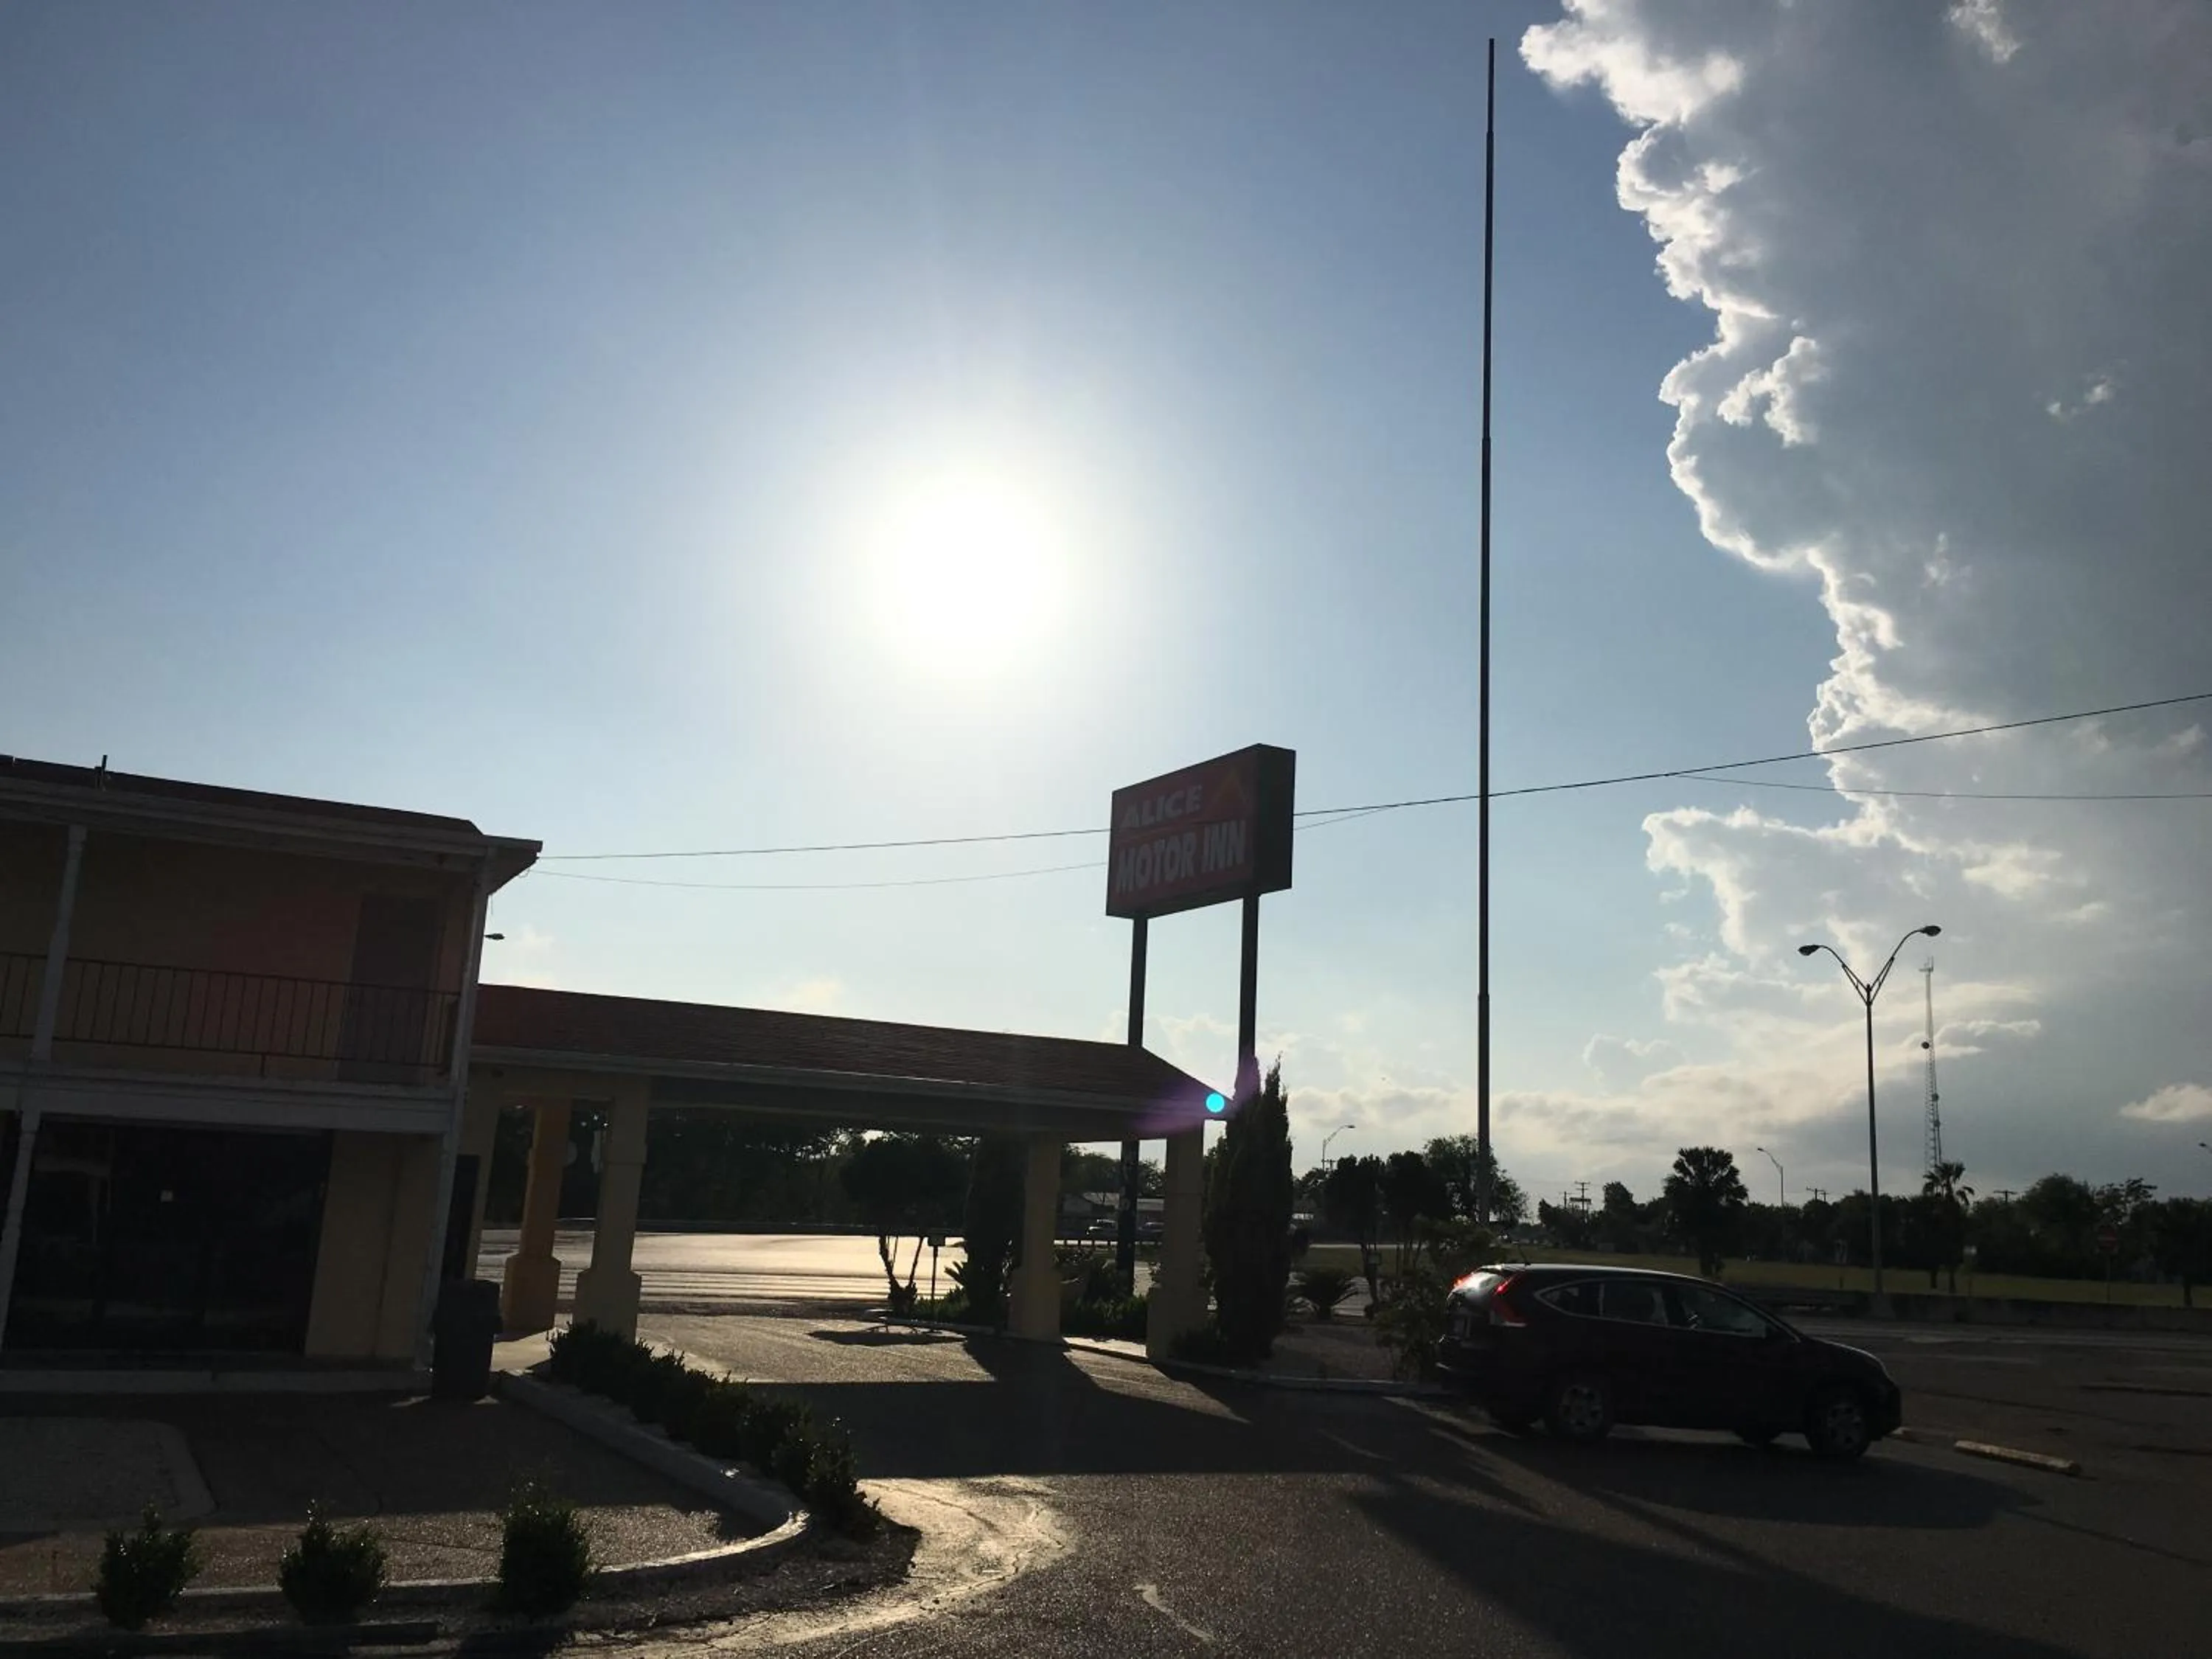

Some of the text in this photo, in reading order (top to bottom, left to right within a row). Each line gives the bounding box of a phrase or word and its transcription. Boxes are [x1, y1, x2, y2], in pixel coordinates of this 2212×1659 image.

[1121, 785, 1202, 827] ALICE
[1116, 820, 1246, 893] MOTOR INN
